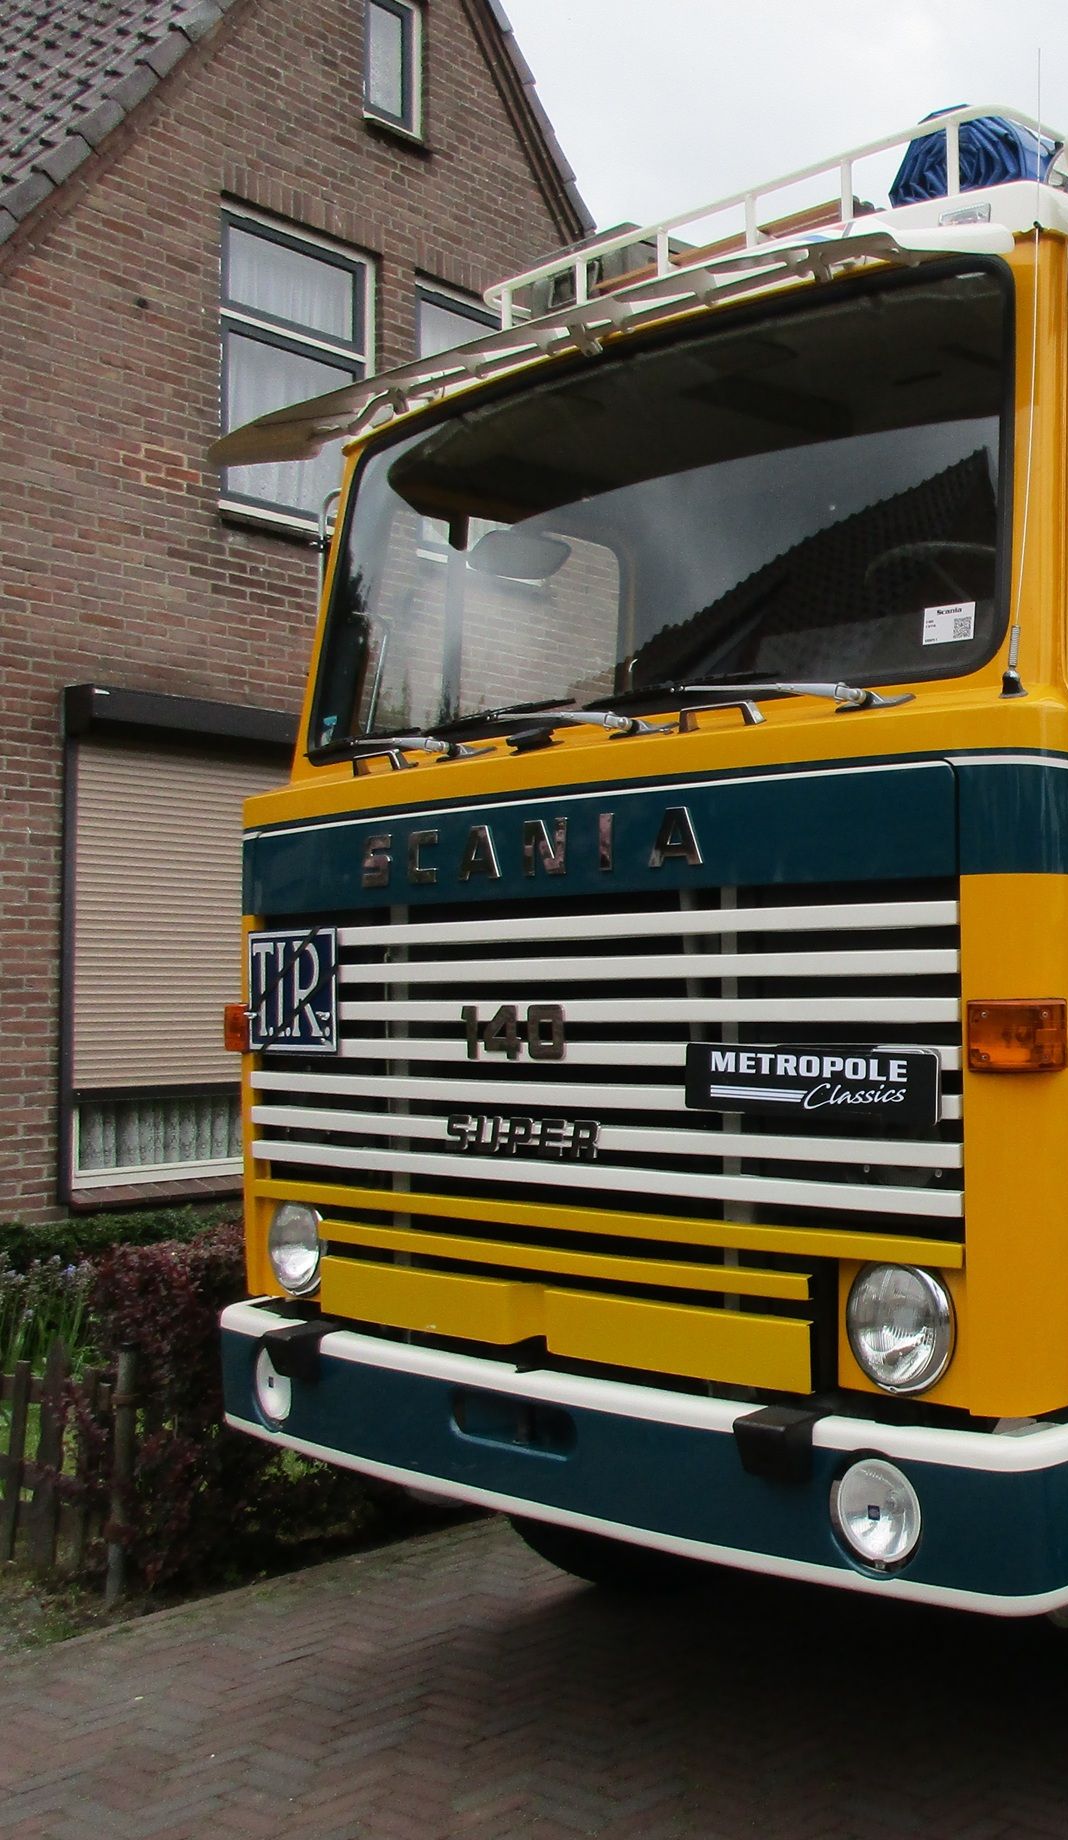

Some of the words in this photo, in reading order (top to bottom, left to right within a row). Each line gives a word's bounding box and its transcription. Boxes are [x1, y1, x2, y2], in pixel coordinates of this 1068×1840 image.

[937, 607, 962, 615] Scania
[361, 806, 704, 888] SCANIA
[461, 1004, 567, 1061] 140
[710, 1051, 908, 1083] METROPOLE
[803, 1082, 907, 1110] Classics
[445, 1114, 602, 1160] SUPER
